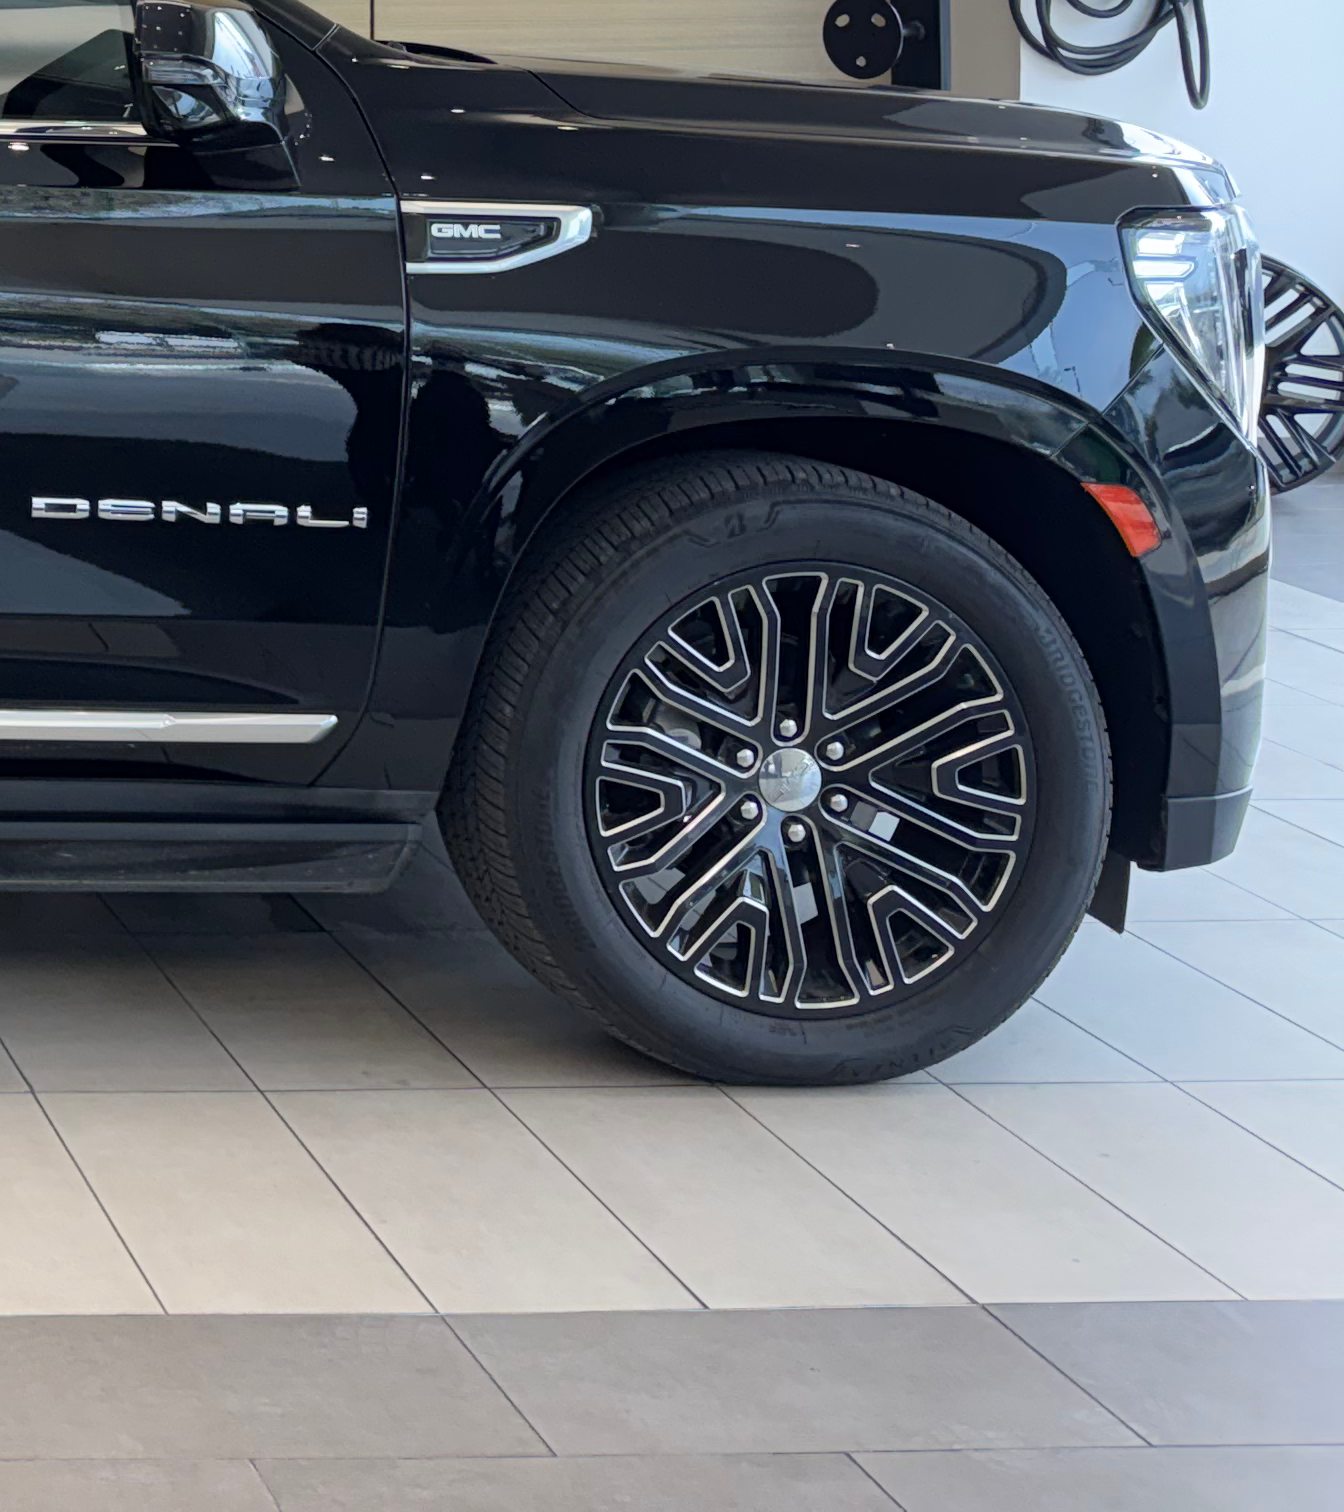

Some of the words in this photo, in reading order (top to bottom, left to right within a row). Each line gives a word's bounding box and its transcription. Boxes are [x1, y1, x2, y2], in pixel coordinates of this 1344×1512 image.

[430, 223, 502, 239] GMC
[31, 496, 368, 529] DENALI
[1034, 624, 1100, 795] BRIDGESTONE
